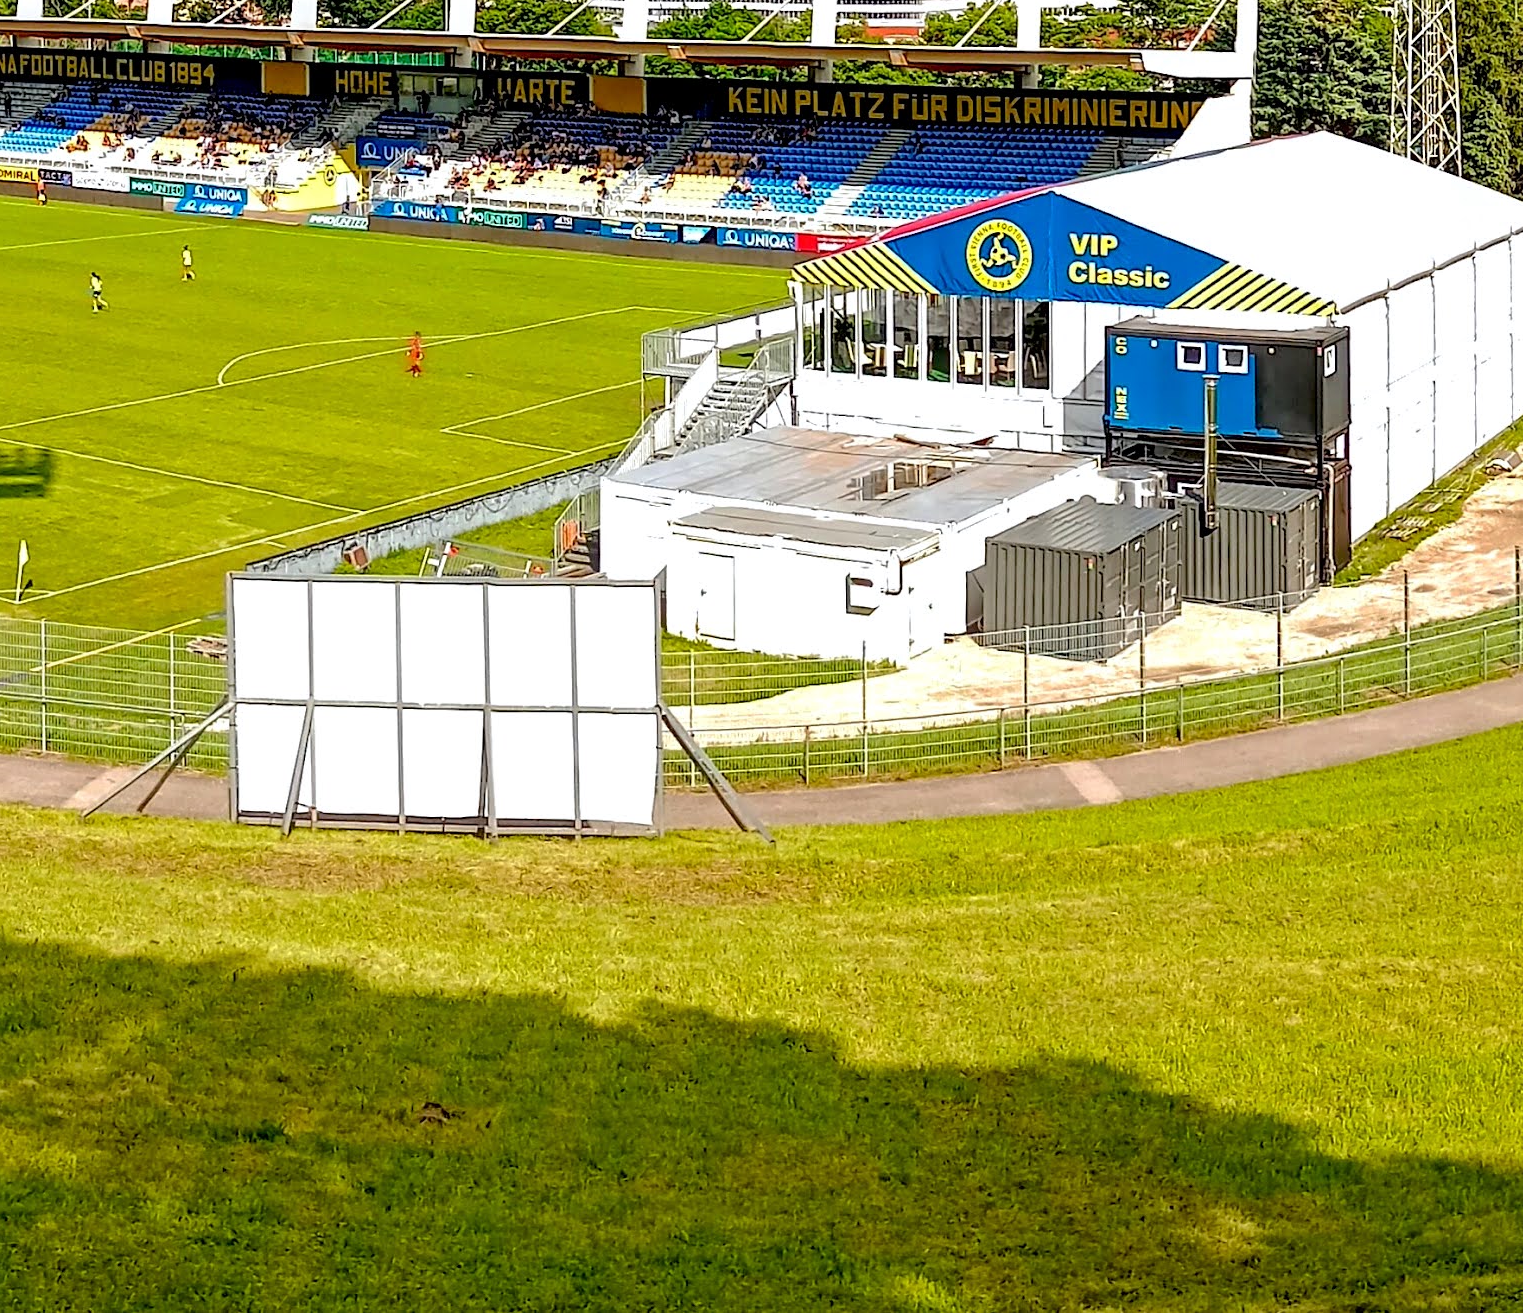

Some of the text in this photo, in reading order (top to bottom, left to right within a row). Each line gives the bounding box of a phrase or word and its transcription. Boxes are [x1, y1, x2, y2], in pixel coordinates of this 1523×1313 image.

[19, 54, 114, 80] FOOTBALL
[116, 58, 166, 83] CLUB
[168, 61, 215, 86] 1894
[335, 69, 392, 96] HOHE
[728, 86, 788, 115] KEIN
[794, 89, 885, 120] PLATZ
[892, 92, 948, 123] FÜR
[208, 186, 243, 202] UNIQA
[744, 233, 789, 249] UNIQA
[996, 222, 1028, 254] FOOTBALL
[1069, 233, 1119, 257] VIP
[1068, 261, 1171, 289] Classic
